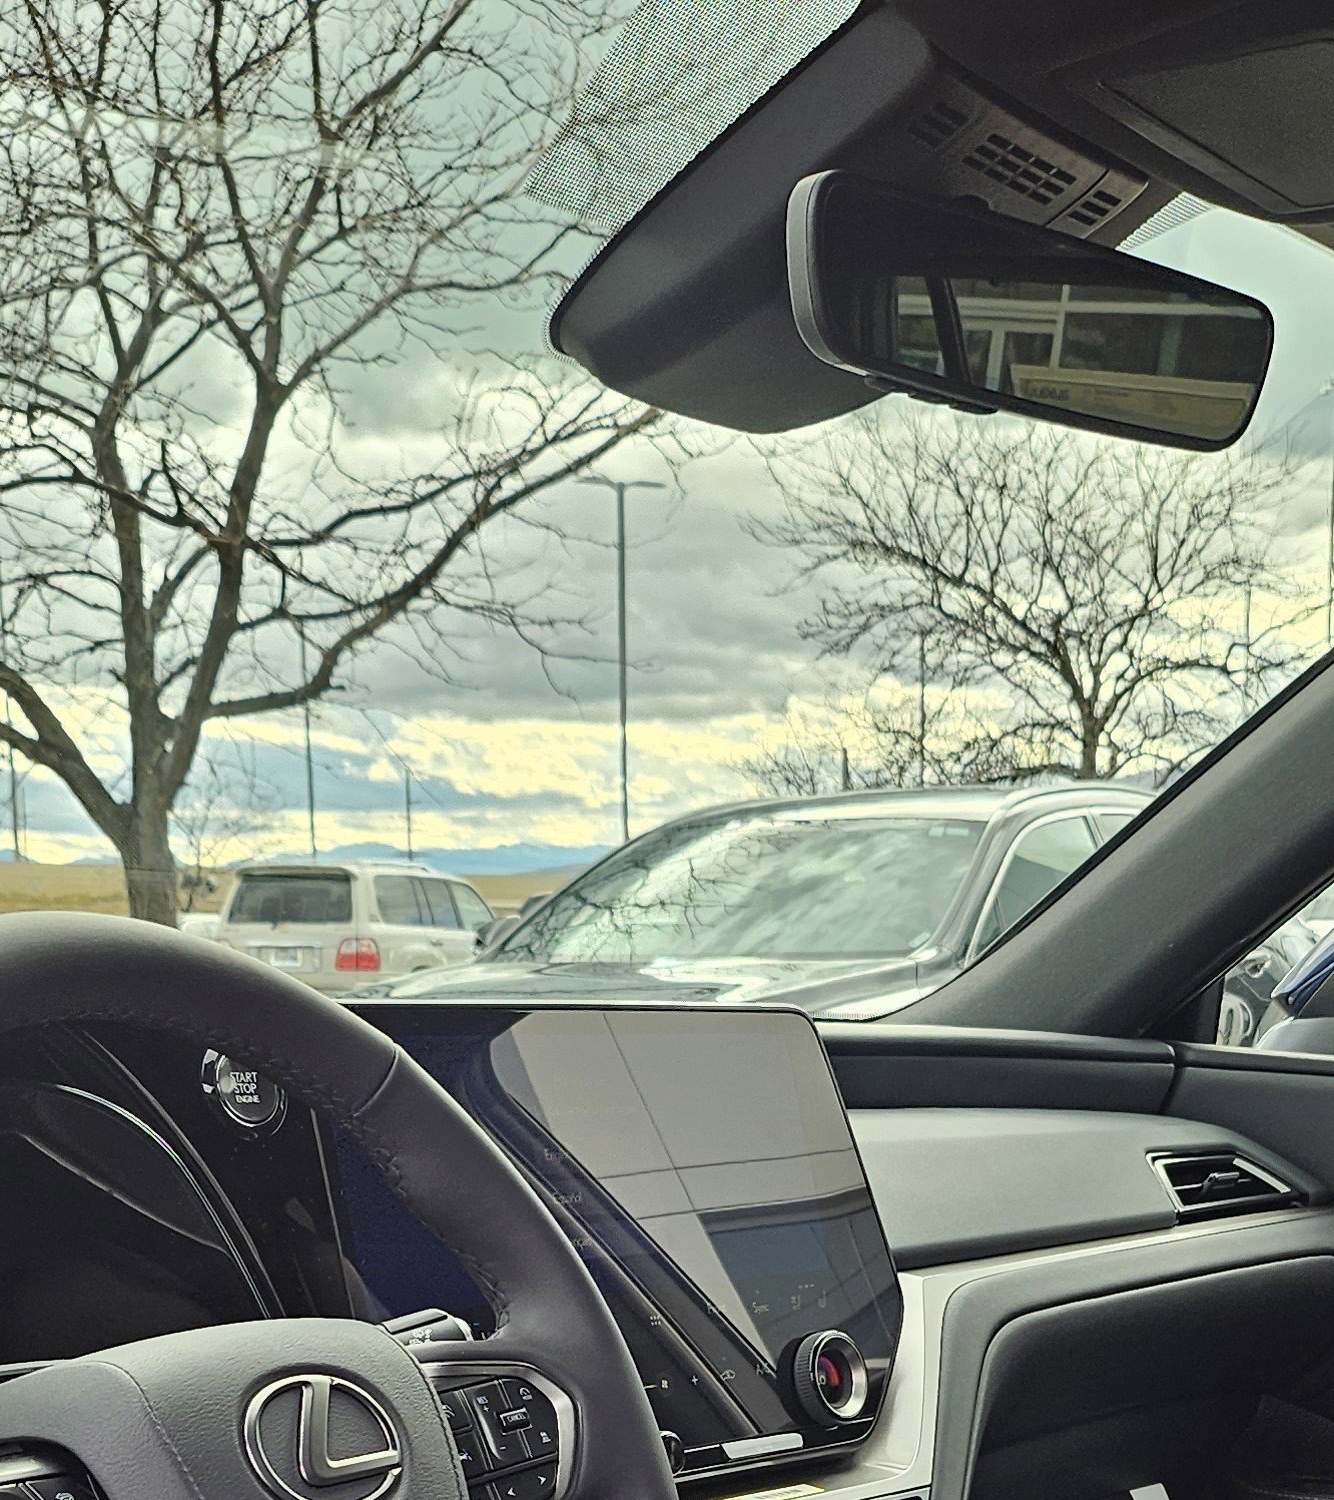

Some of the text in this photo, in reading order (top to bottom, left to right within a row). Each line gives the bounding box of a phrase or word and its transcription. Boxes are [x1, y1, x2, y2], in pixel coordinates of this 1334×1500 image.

[230, 1071, 258, 1083] START
[234, 1083, 257, 1094] STOP
[507, 1411, 527, 1423] CANCEL
